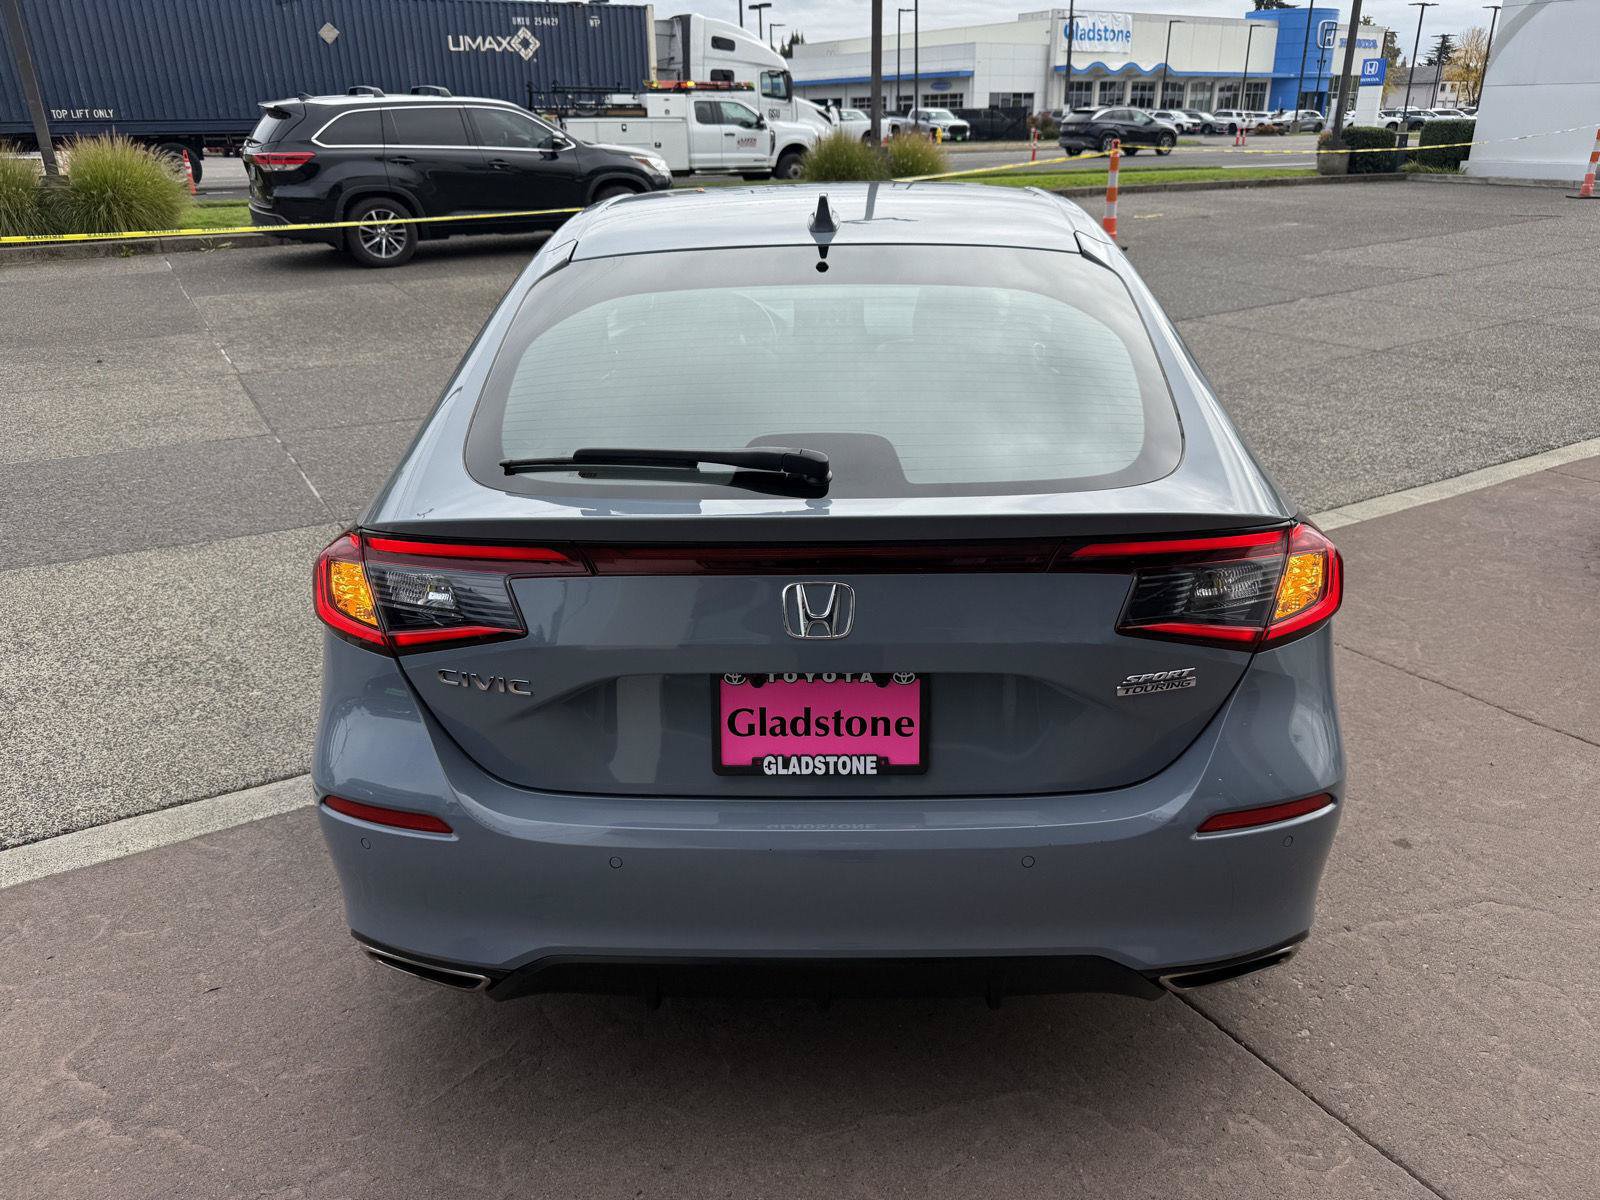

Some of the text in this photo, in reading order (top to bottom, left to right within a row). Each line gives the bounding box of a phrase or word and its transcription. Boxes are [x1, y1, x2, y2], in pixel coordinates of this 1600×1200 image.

[447, 35, 515, 52] UMAX
[51, 109, 114, 119] TOP LIFT ONLY
[438, 668, 532, 696] CIVIC
[767, 672, 873, 684] TOYOTA
[1122, 667, 1196, 684] SPORT
[1124, 681, 1192, 695] TOURING
[727, 706, 915, 737] Gladstone
[762, 755, 878, 775] GLADSTONE
